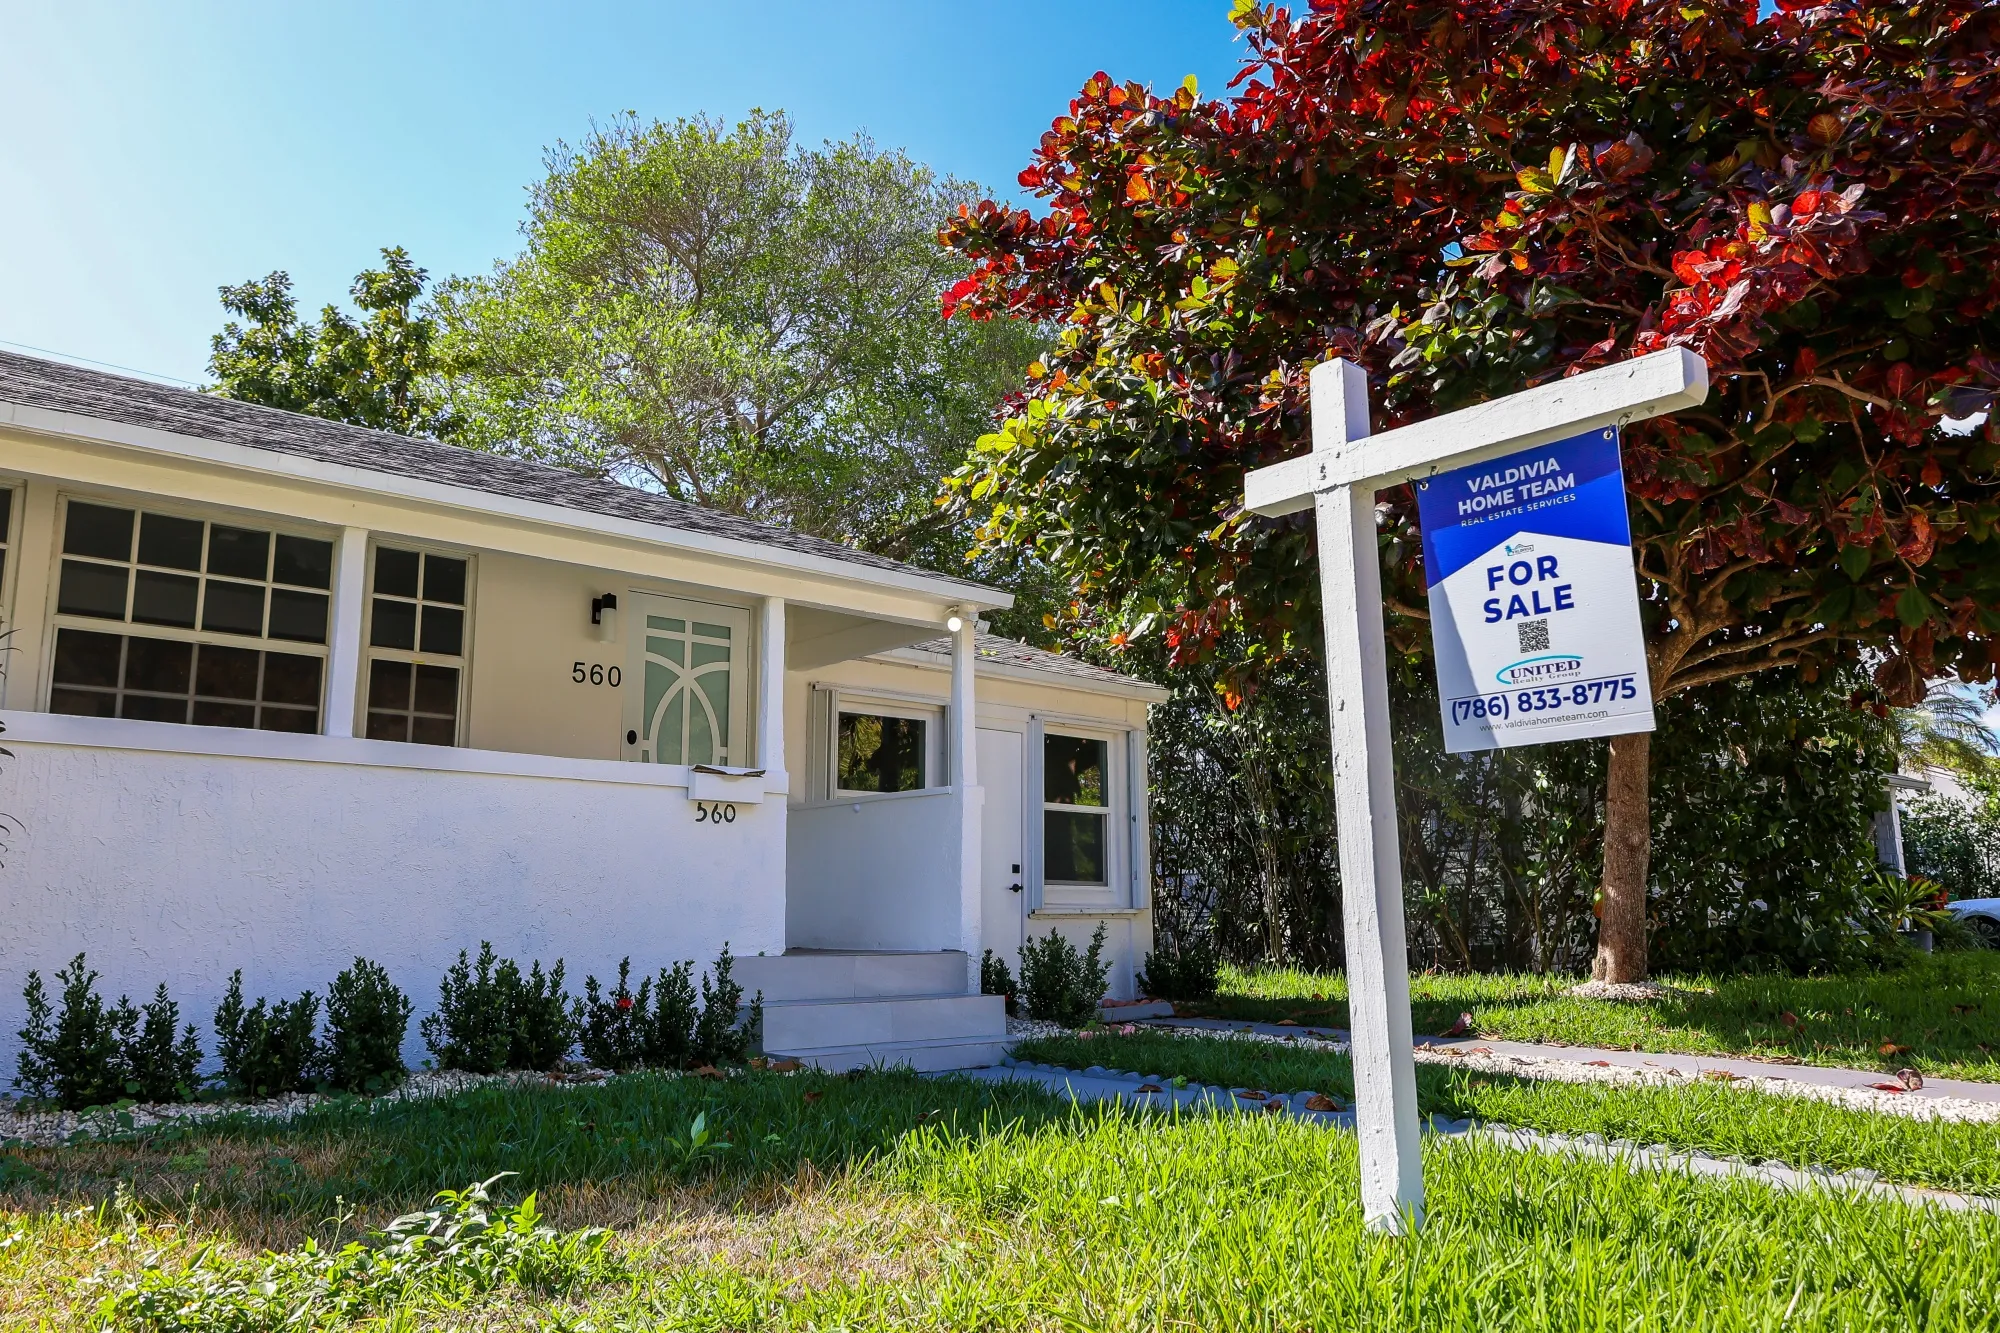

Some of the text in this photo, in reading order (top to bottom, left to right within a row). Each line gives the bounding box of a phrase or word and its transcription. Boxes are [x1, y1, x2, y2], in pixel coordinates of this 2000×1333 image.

[1467, 457, 1561, 493] VALDIVIA
[1458, 473, 1575, 516] HOME TEAM
[1461, 493, 1576, 527] REAL ESTATE SERVICES
[1486, 555, 1560, 592] FOR
[1483, 584, 1575, 624] SALE
[572, 661, 622, 687] 560
[1509, 659, 1581, 679] UNITED
[1512, 671, 1581, 685] Realty Group
[1451, 677, 1637, 726] (786) 833-8775
[695, 802, 736, 824] 560
